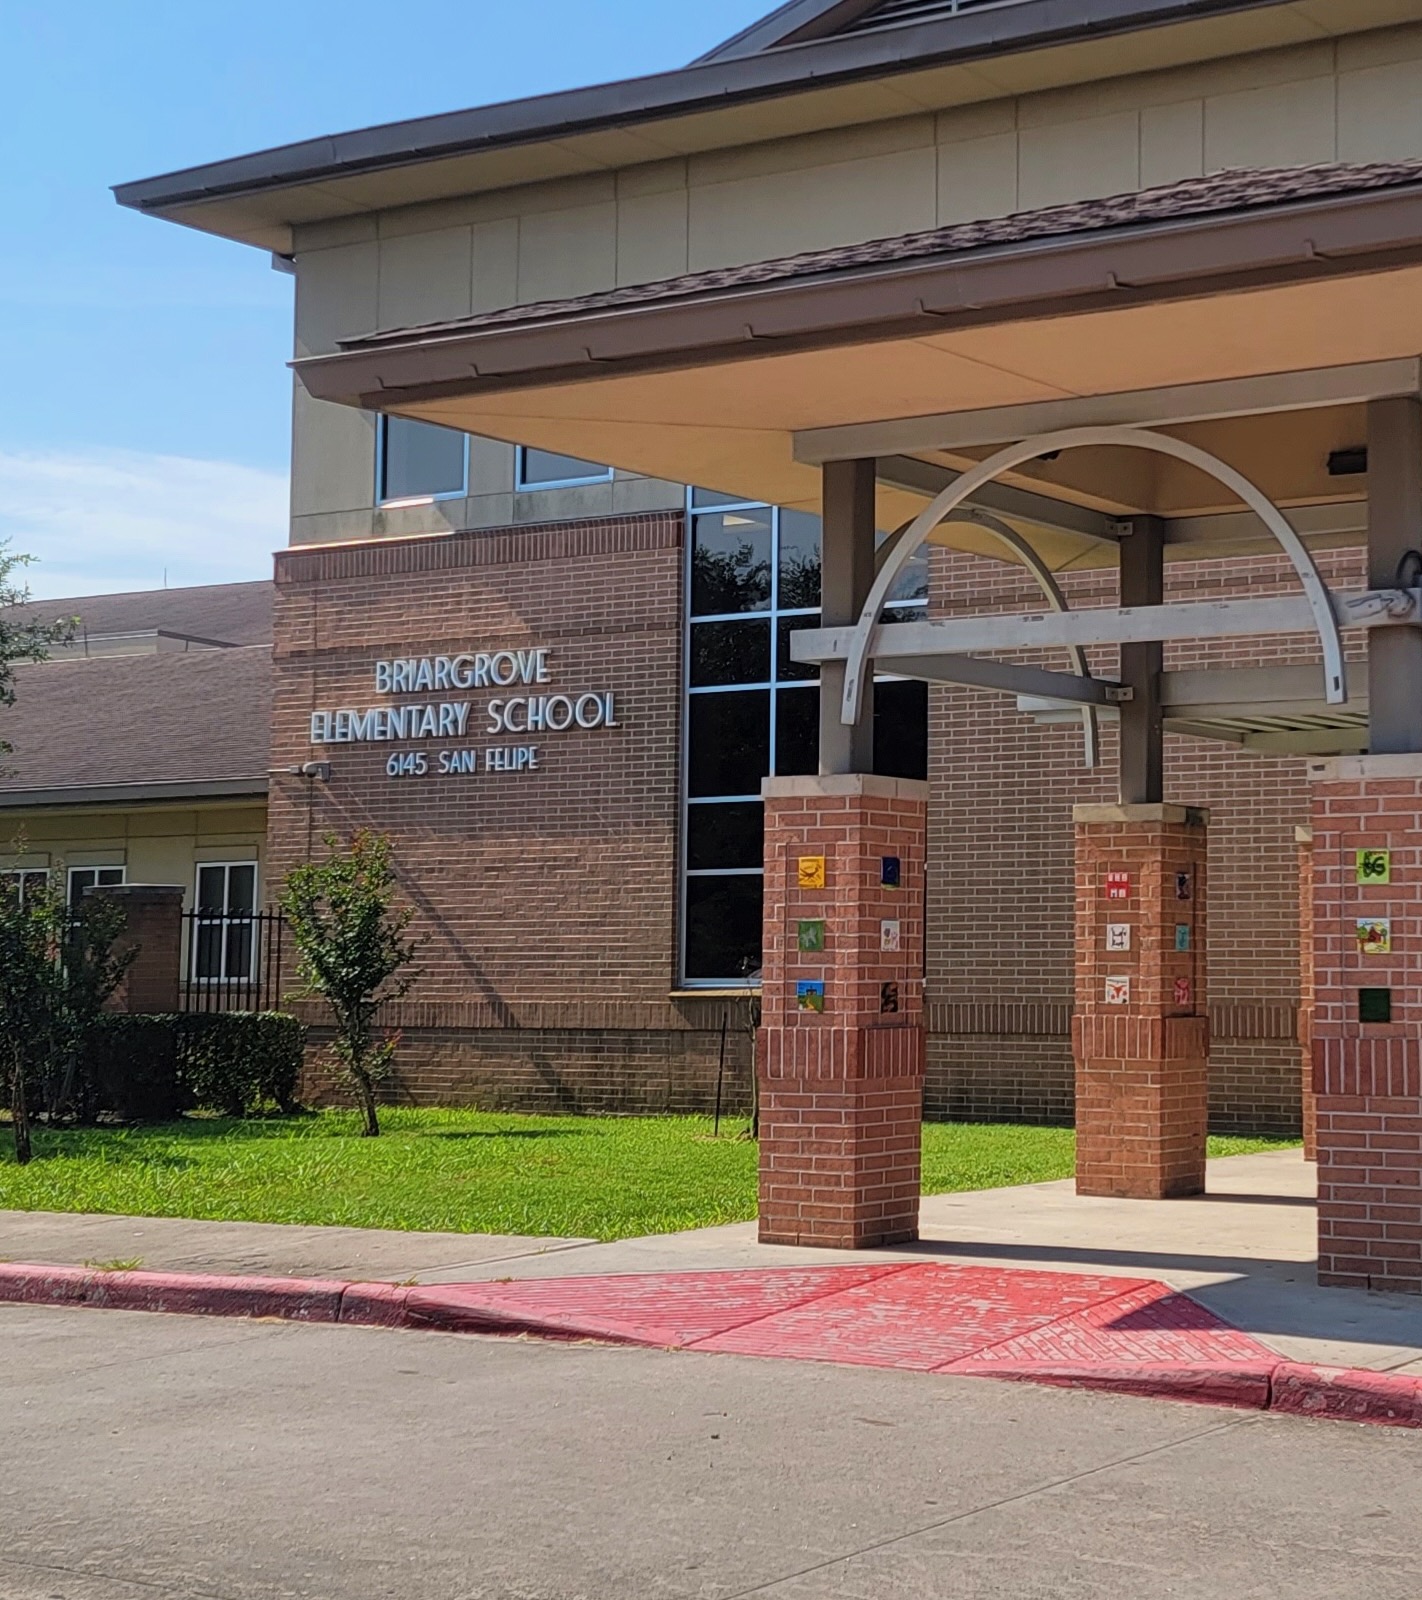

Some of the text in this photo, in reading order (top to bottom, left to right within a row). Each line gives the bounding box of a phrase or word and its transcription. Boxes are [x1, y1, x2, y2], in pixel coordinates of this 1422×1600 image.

[375, 649, 551, 693] BRIARGROVE
[310, 692, 620, 744] ELEMENTARY SCHOOL
[386, 746, 539, 776] 6145 SAN FELIPE
